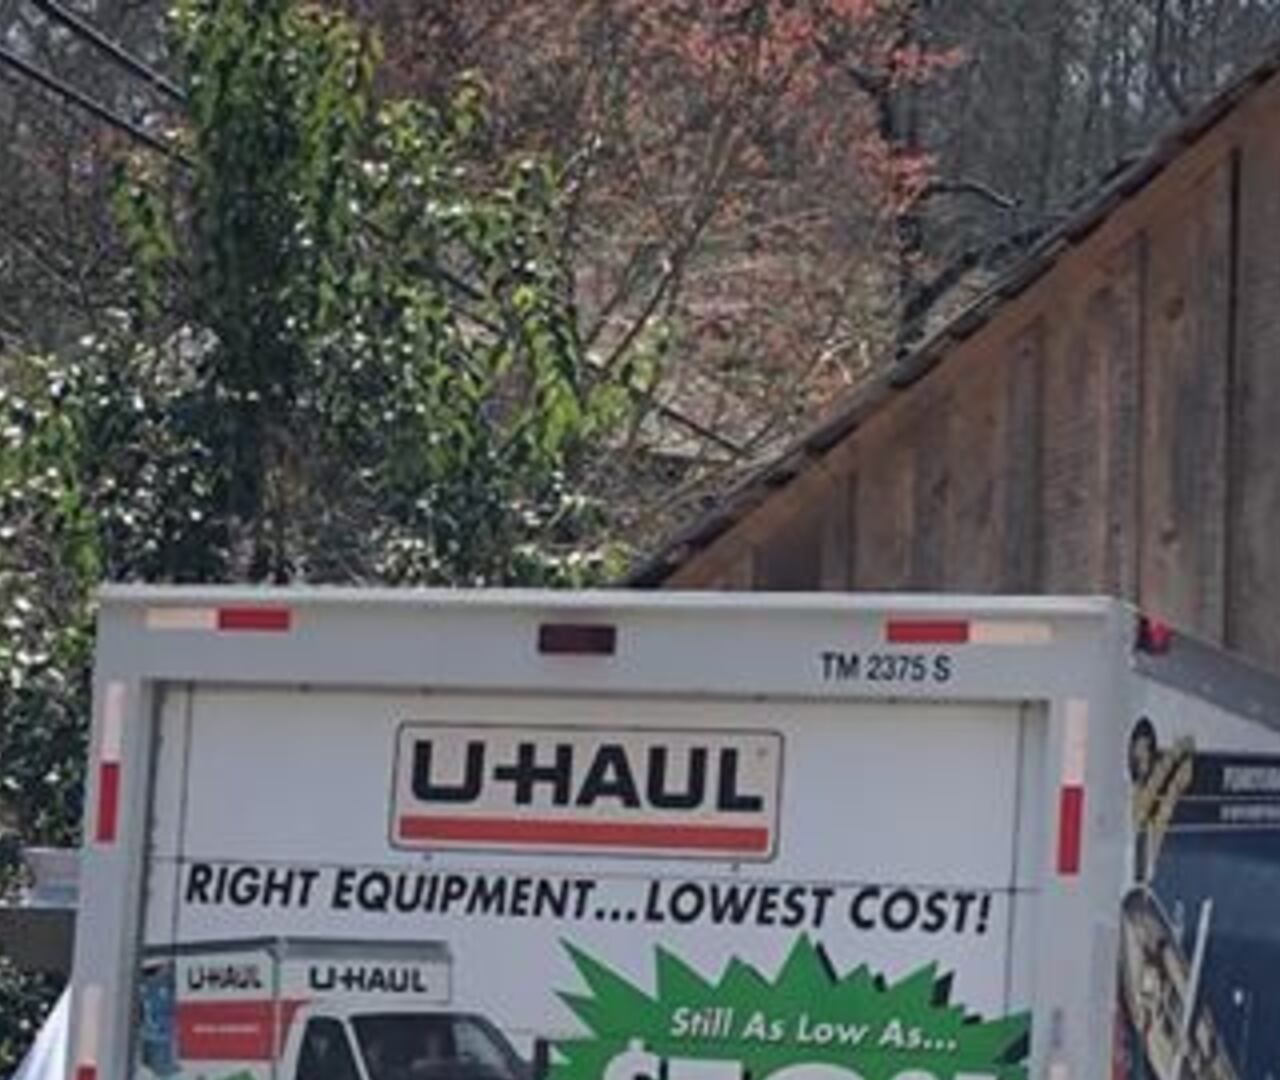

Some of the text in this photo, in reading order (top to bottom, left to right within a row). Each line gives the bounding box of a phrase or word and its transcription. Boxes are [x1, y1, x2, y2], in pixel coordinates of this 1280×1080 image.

[821, 651, 952, 683] TM 2375 S
[411, 740, 764, 812] U-HAUL
[185, 862, 320, 909] RIGHT
[849, 885, 993, 935] COST!
[671, 1007, 732, 1039] Still
[742, 1011, 785, 1041] As
[797, 1013, 868, 1045] Low
